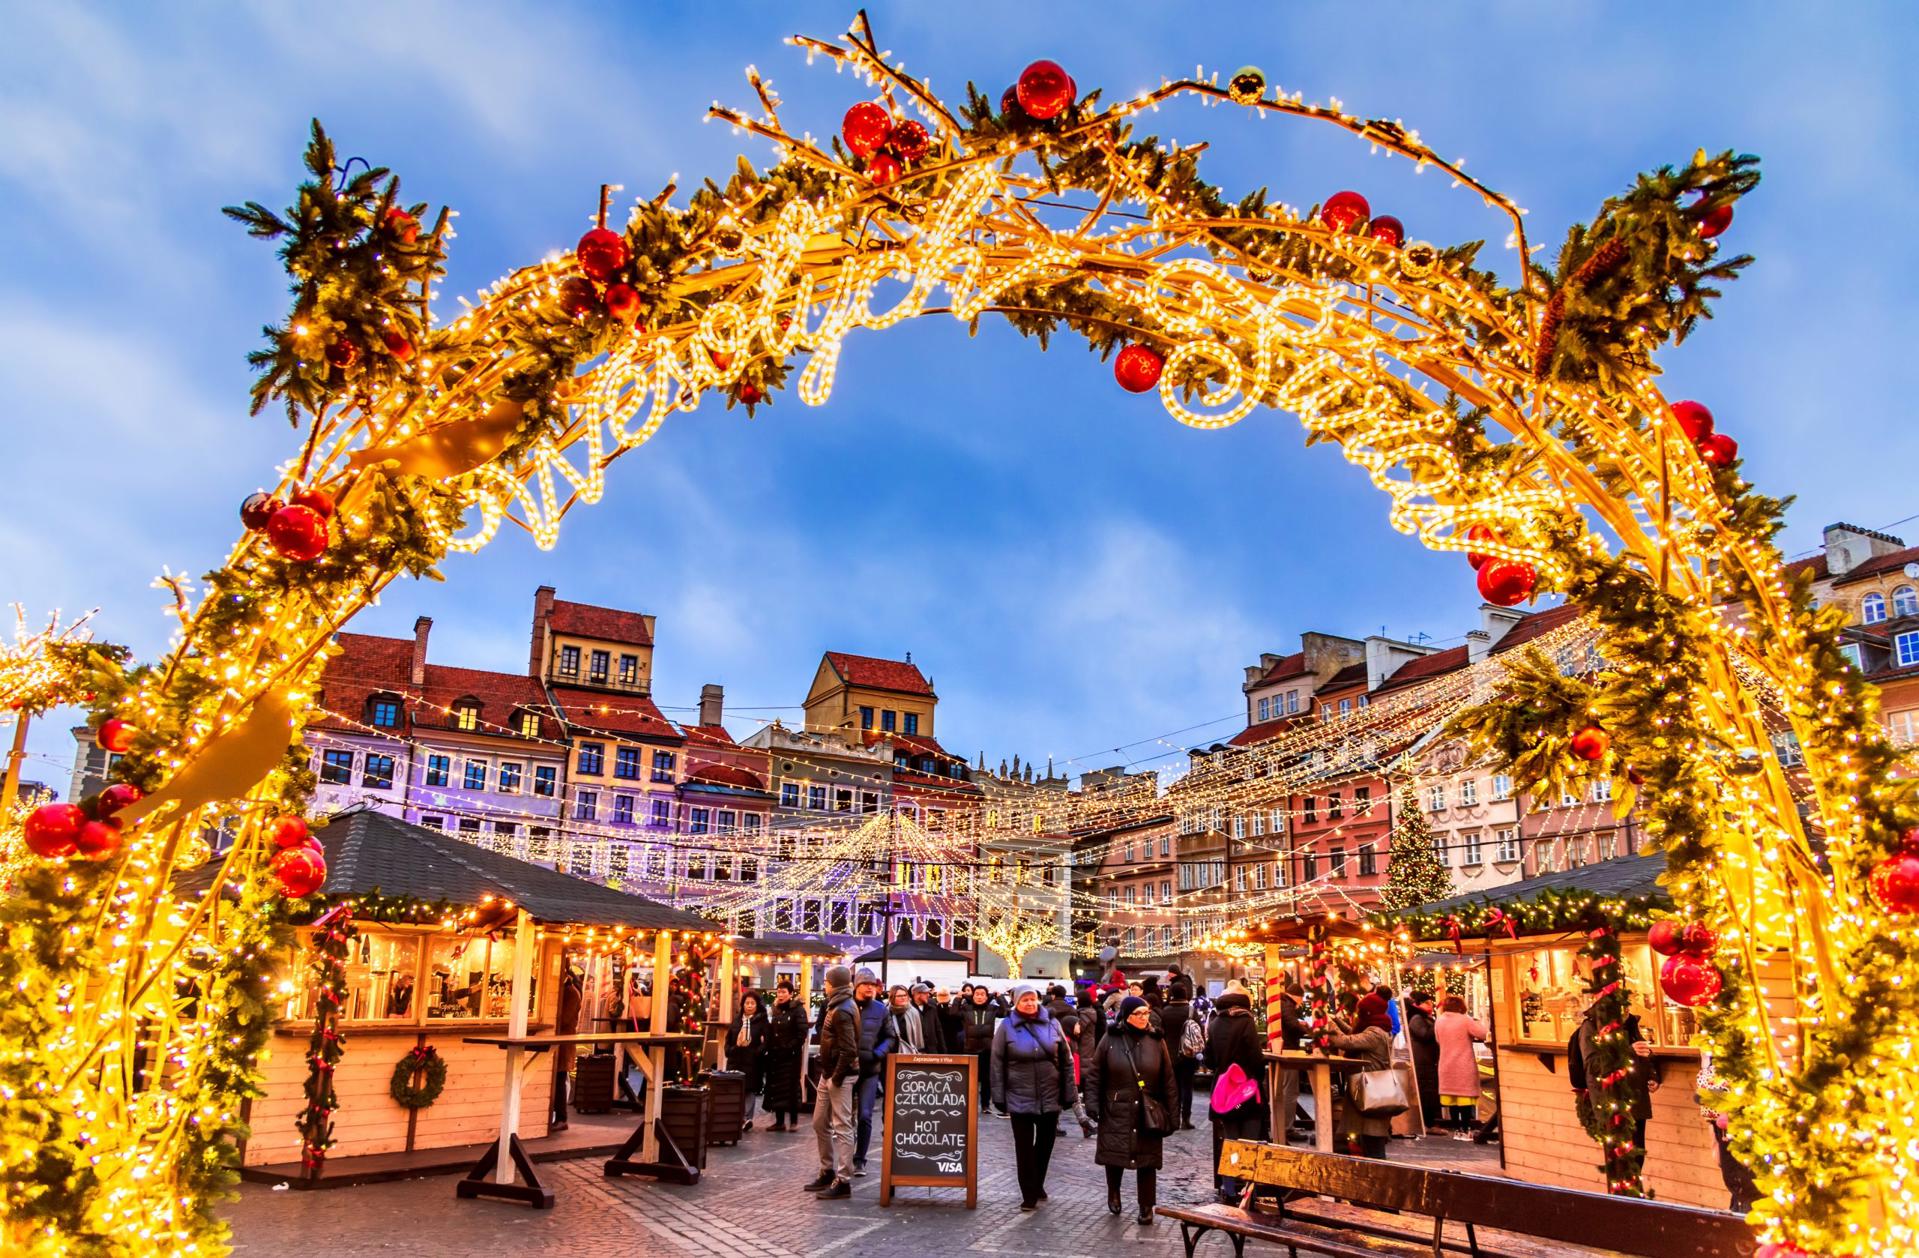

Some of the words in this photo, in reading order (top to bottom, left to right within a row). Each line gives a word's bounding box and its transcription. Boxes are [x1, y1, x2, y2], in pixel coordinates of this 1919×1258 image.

[901, 1081, 951, 1093] GORĄCA
[895, 1094, 966, 1106] CZEKOLADA
[914, 1121, 940, 1132] HOT
[895, 1133, 966, 1147] CHOCOLATE
[936, 1161, 963, 1173] VISA
